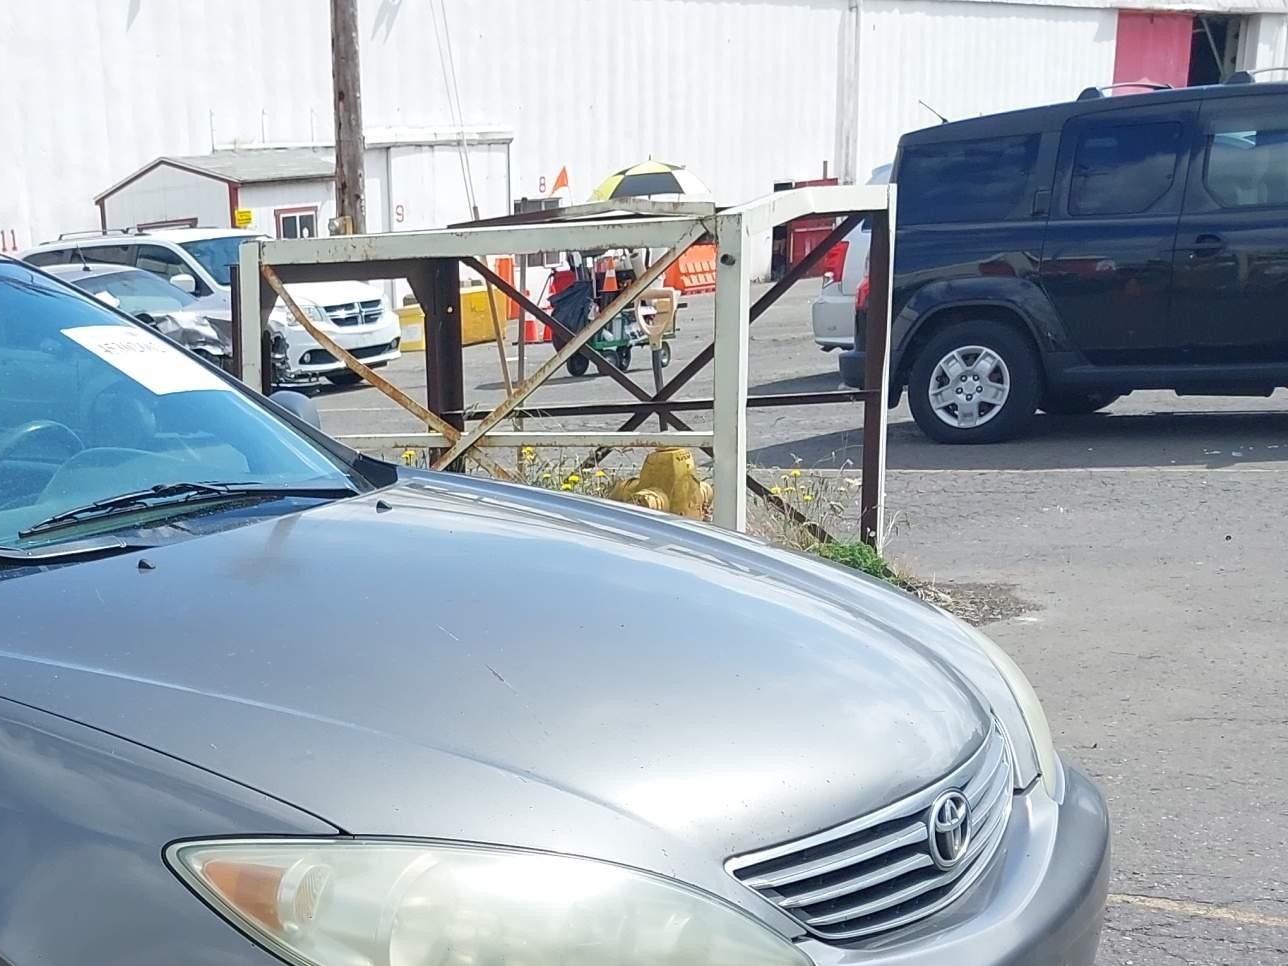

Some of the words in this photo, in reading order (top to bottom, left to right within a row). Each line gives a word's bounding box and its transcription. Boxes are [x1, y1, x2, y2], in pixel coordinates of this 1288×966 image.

[538, 176, 547, 193] 8
[395, 204, 405, 223] 9
[0, 229, 18, 253] 11
